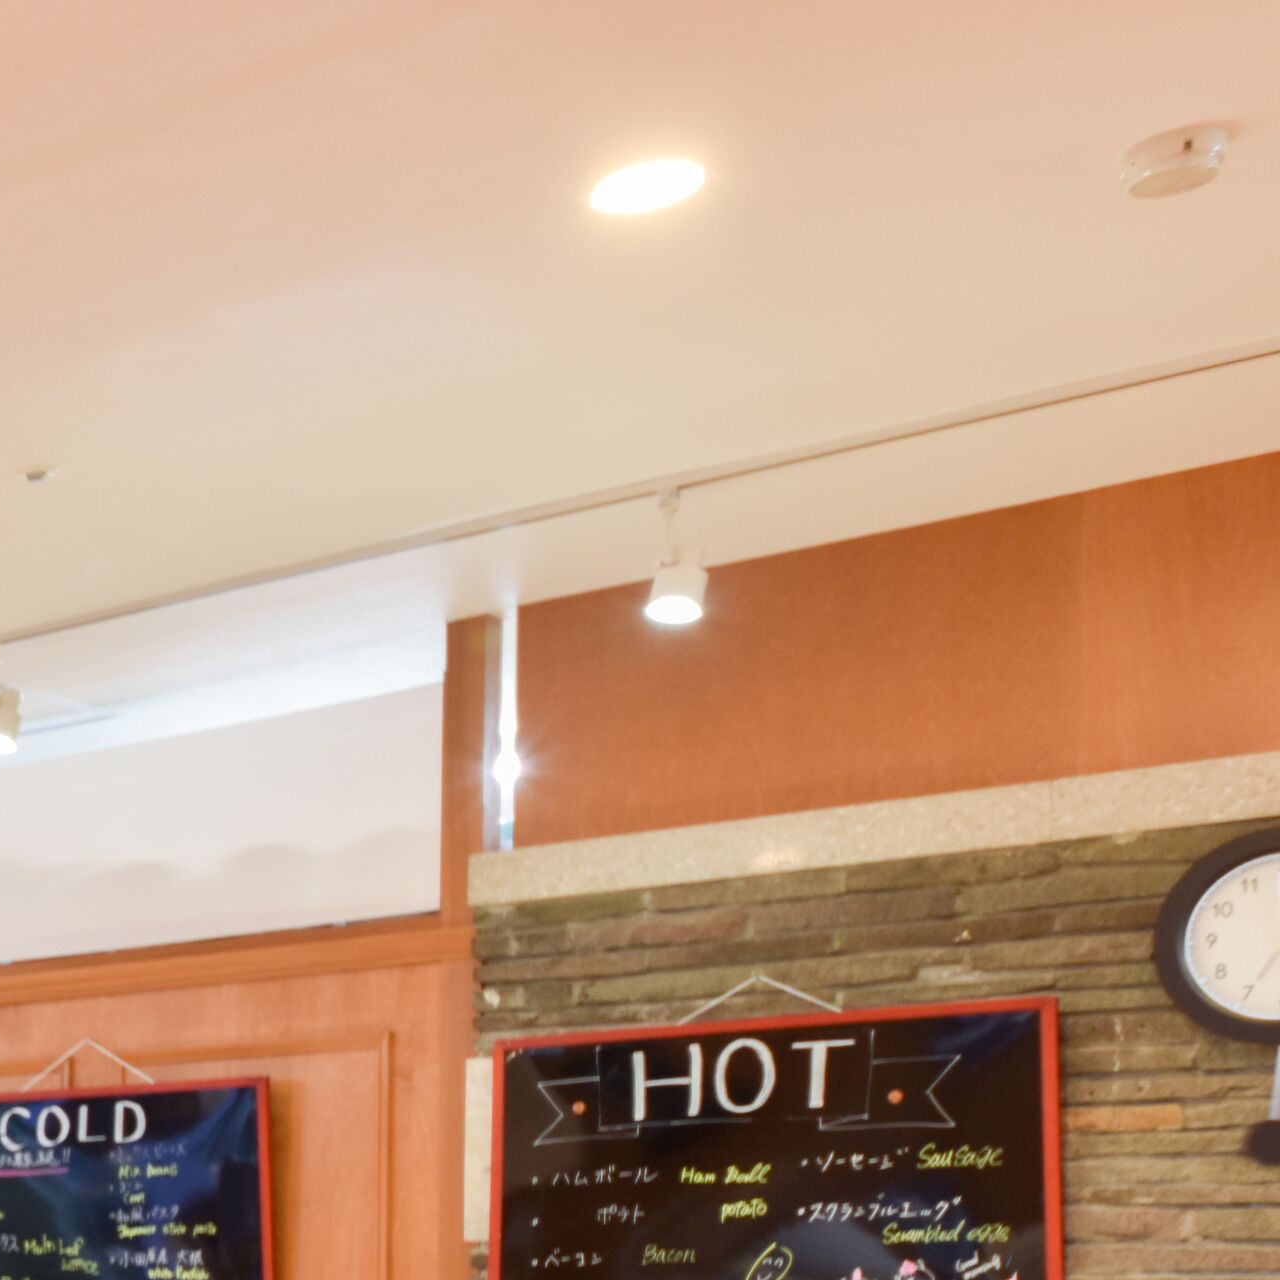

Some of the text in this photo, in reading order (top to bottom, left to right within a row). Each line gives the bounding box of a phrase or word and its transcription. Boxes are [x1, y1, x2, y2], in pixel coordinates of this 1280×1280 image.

[1241, 877, 1258, 893] 11
[1214, 901, 1233, 918] 10
[1206, 933, 1218, 949] 9
[1214, 963, 1227, 979] 8
[1242, 985, 1254, 1001] 7
[631, 1037, 856, 1121] HOT
[916, 1142, 1003, 1169] Sausage
[641, 1243, 697, 1266] Bacon
